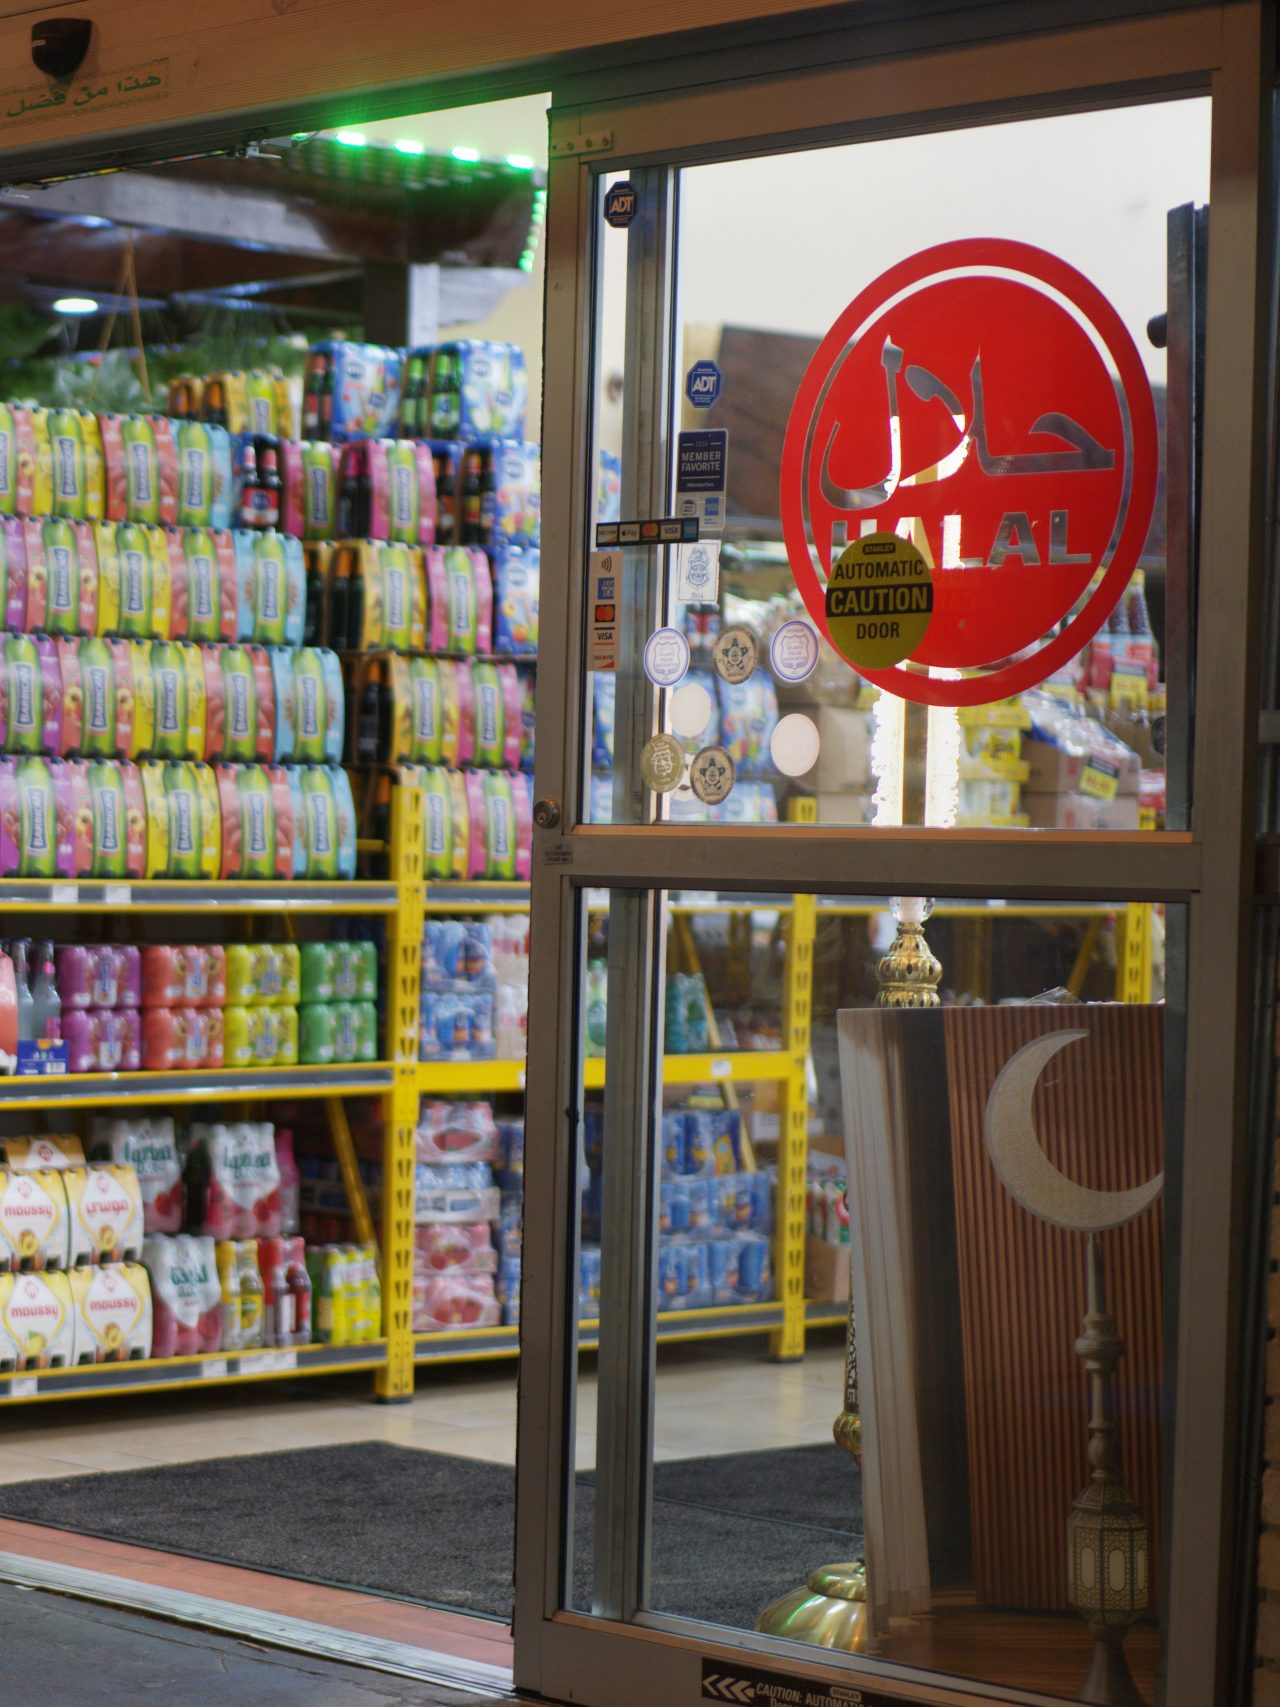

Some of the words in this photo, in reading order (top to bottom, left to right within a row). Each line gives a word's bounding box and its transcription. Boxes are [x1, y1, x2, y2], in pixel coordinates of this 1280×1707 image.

[610, 195, 634, 214] ADT
[691, 375, 717, 393] ADT
[820, 333, 1116, 511] حلال
[681, 451, 721, 462] MEMBER
[681, 461, 721, 472] FAVORITE
[834, 559, 924, 580] AUTOMATIC
[830, 586, 928, 614] CAUTION
[597, 633, 613, 641] VISA
[856, 622, 900, 640] DOOR
[4, 1205, 53, 1218] moussy
[11, 1305, 59, 1318] moussy
[90, 1298, 138, 1312] moussy
